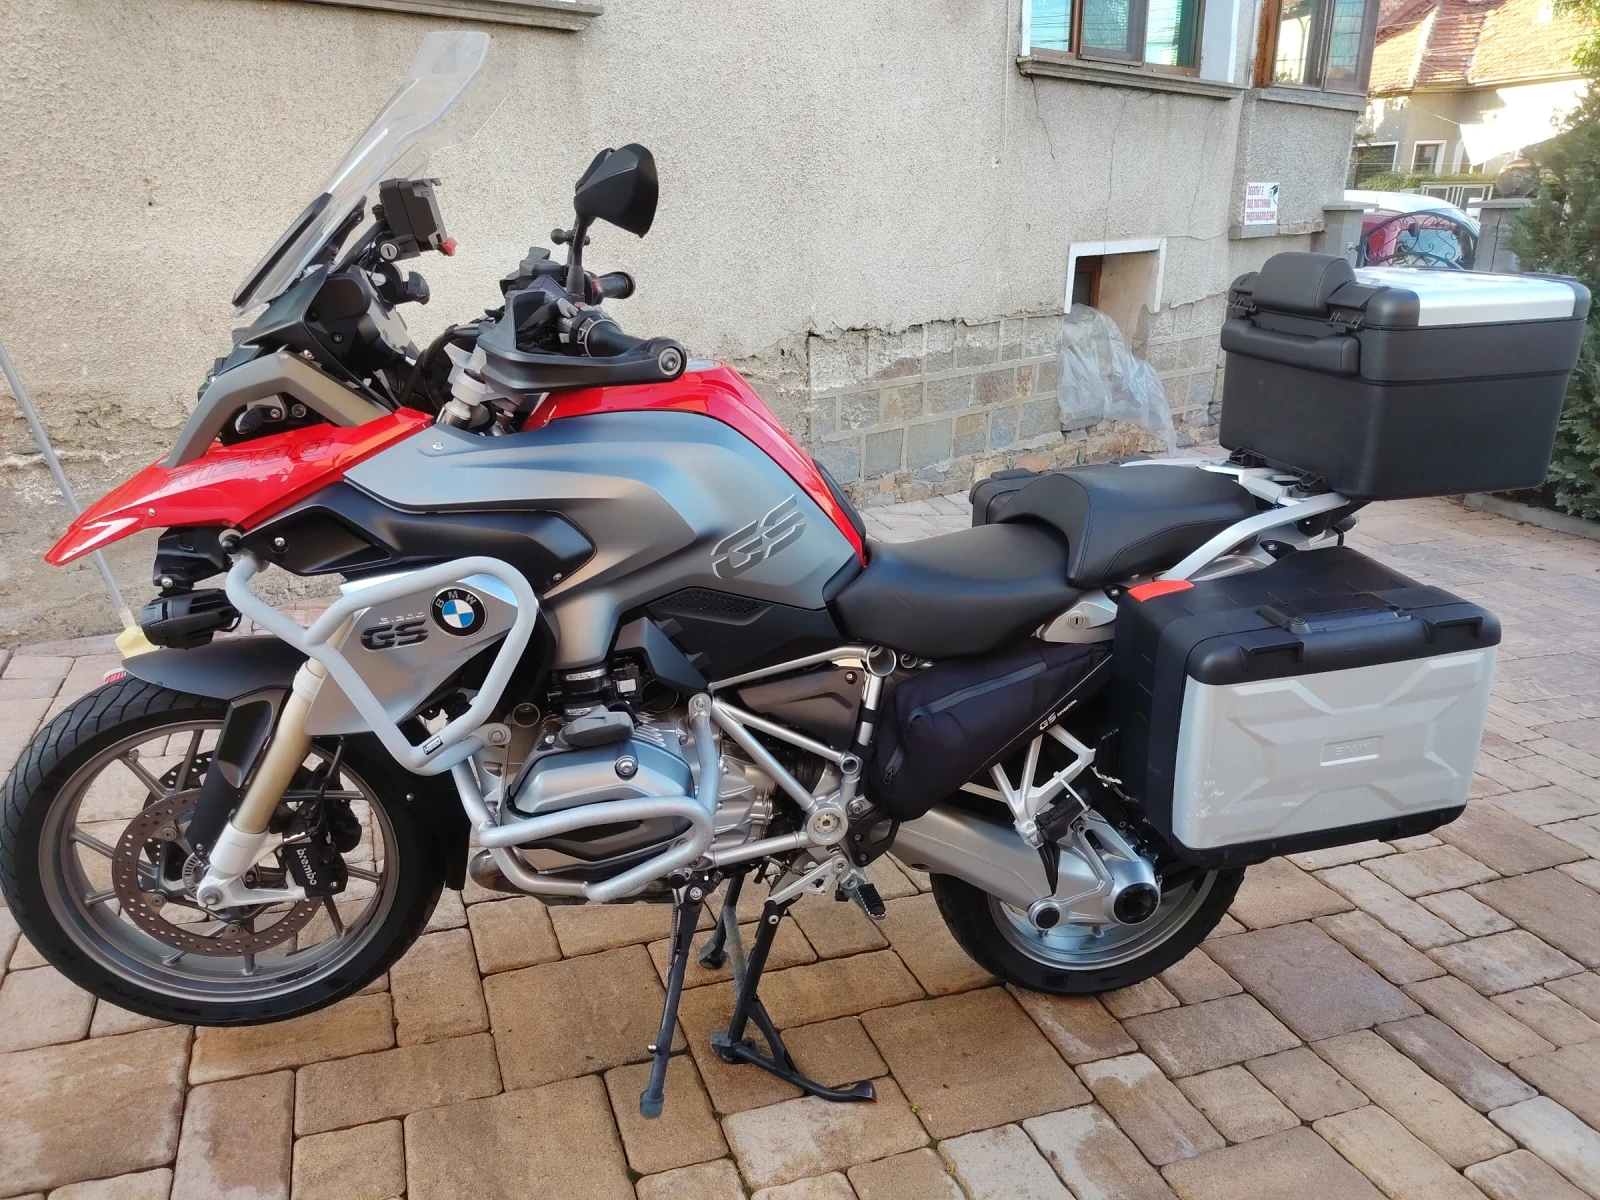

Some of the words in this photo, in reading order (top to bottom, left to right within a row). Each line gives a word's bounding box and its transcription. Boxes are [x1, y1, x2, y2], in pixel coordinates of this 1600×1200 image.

[710, 492, 806, 579] GS
[435, 590, 477, 609] BMW
[360, 619, 429, 651] GS
[1039, 711, 1057, 731] GS
[296, 847, 318, 886] brembo
